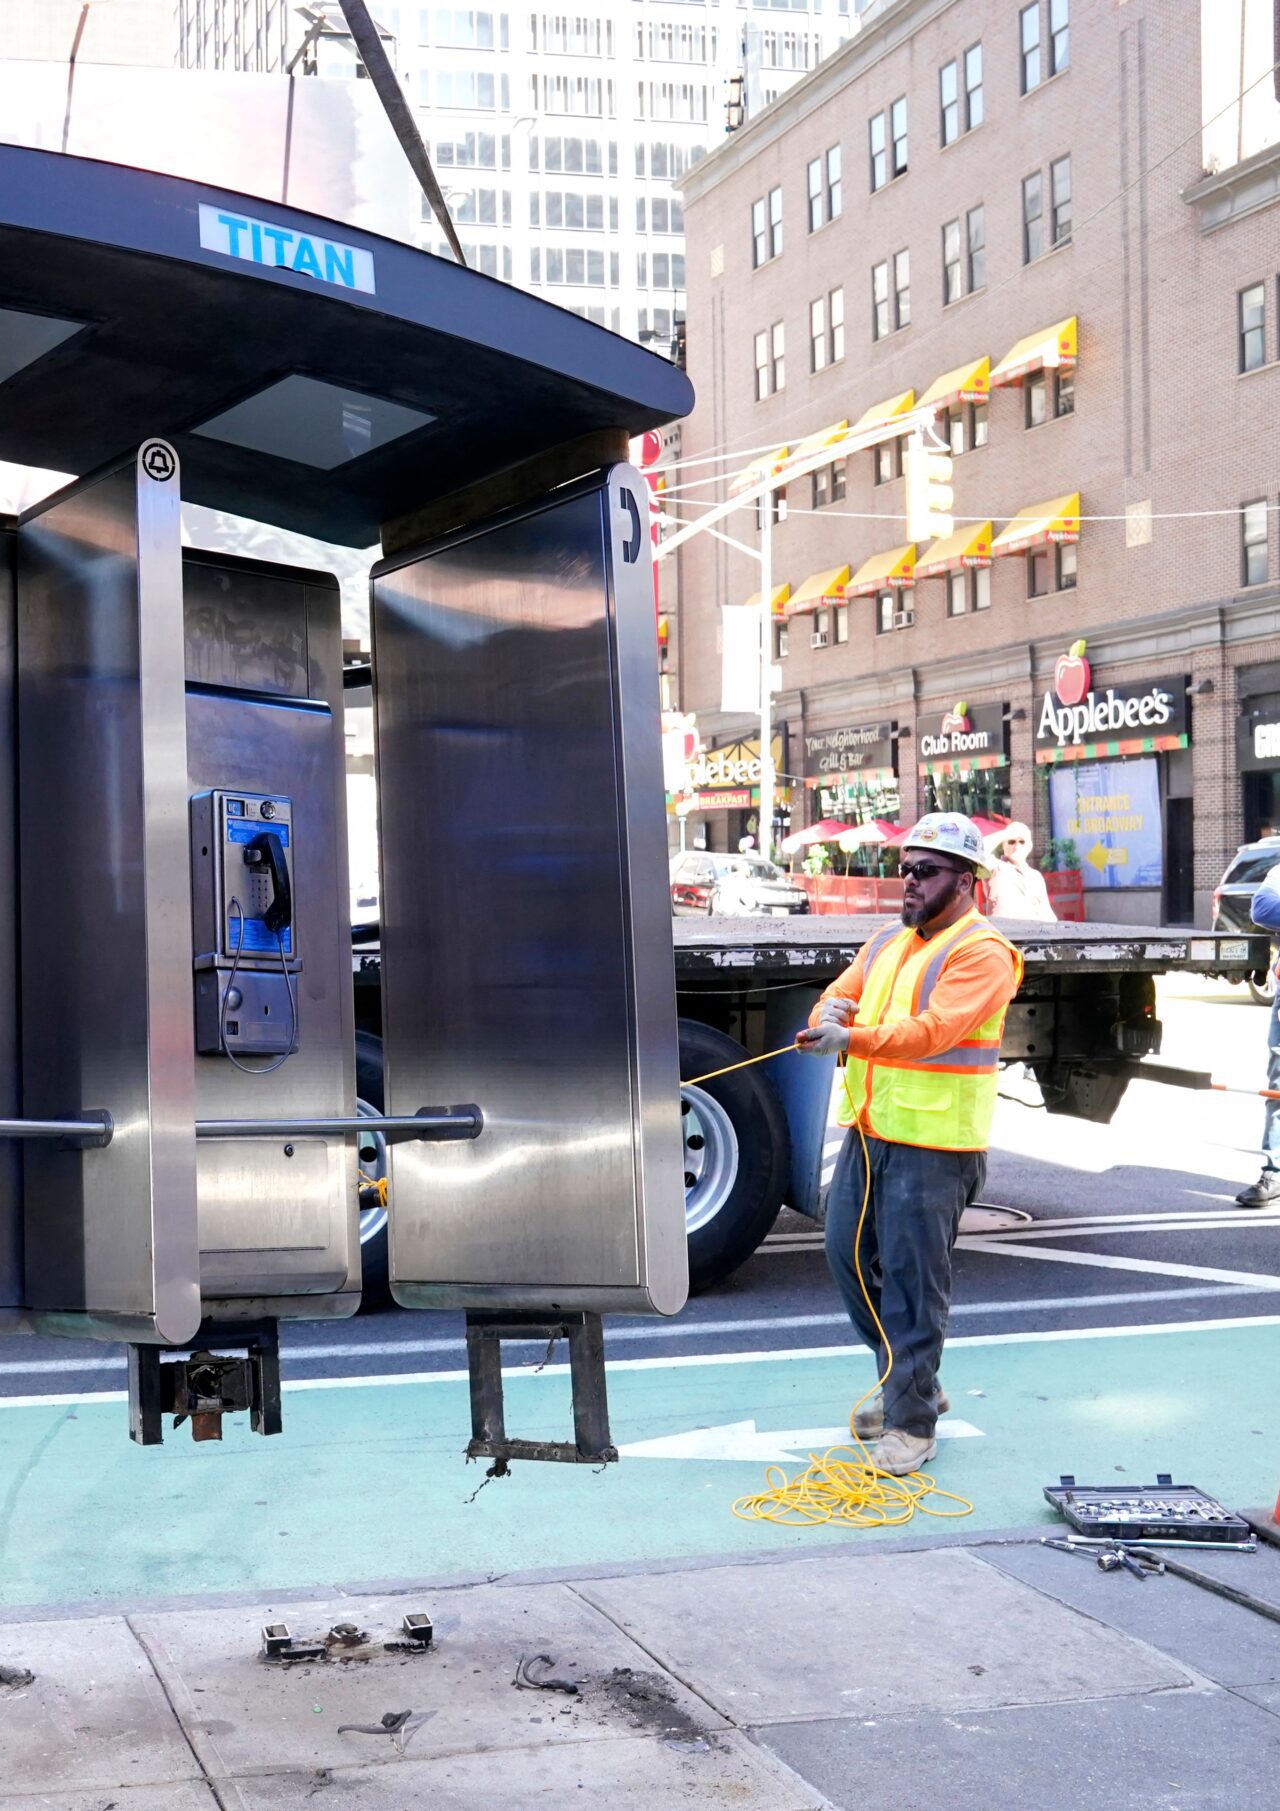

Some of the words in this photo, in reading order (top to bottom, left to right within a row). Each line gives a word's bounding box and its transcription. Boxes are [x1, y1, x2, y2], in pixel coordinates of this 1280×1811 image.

[218, 214, 355, 289] TITAN
[1037, 687, 1170, 746] Applebee's
[805, 737, 824, 757] Your
[825, 728, 880, 751] Neighborhood
[921, 735, 948, 756] Club
[951, 731, 988, 751] Room
[820, 752, 839, 772] Grill
[848, 751, 865, 766] Bar
[700, 793, 748, 805] BREAKFAST
[1084, 815, 1144, 833] BROADWAY
